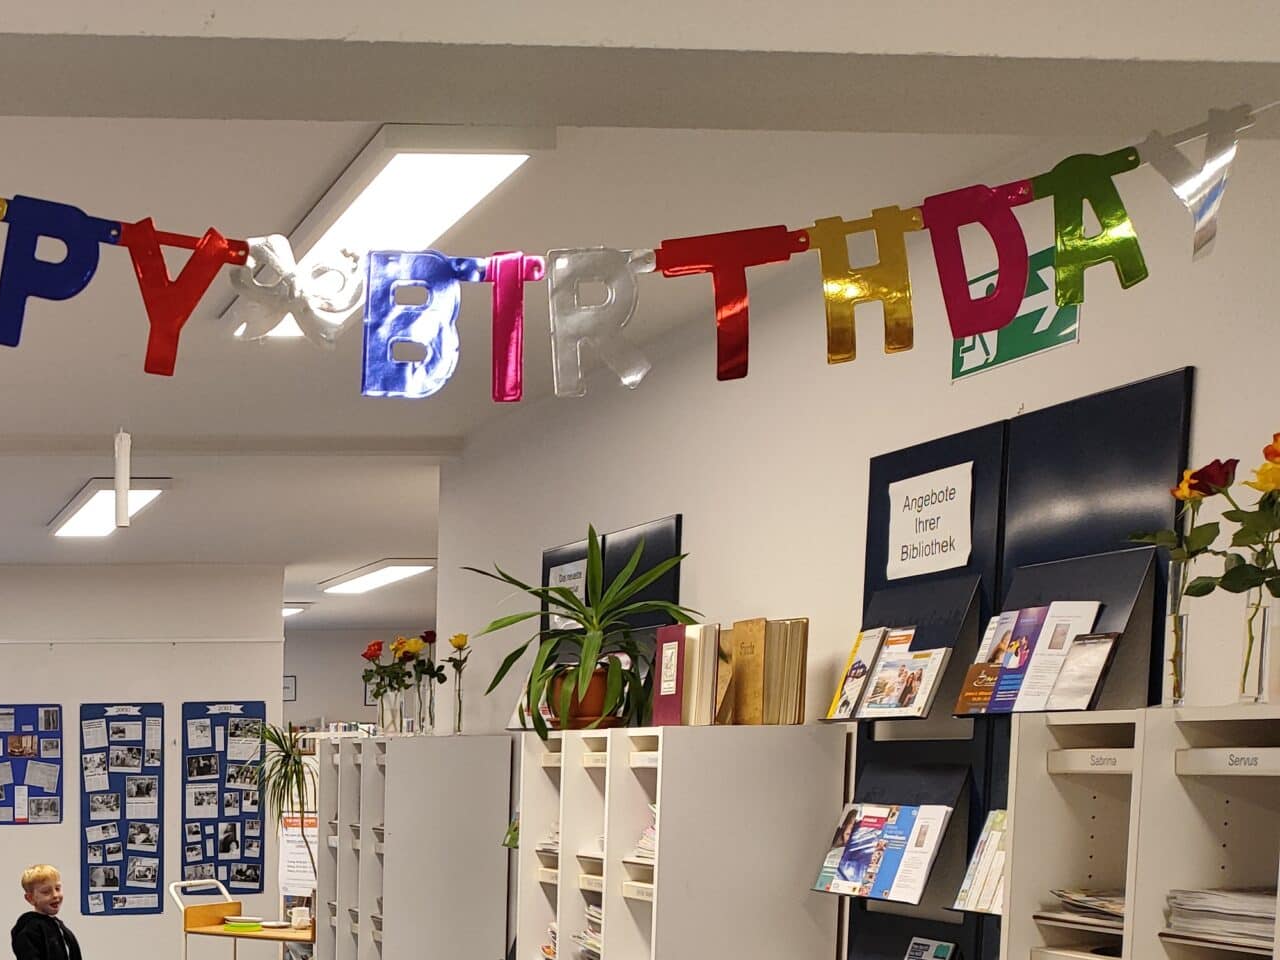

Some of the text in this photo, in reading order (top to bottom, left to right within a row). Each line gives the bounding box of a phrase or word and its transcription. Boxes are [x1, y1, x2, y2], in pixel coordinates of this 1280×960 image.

[361, 104, 1256, 402] BIRTHDAY
[901, 484, 957, 515] Angebote
[913, 512, 942, 536] Ihrer
[899, 536, 957, 563] Bibliothek
[1089, 754, 1117, 769] Sabrina
[1227, 752, 1260, 769] Servus
